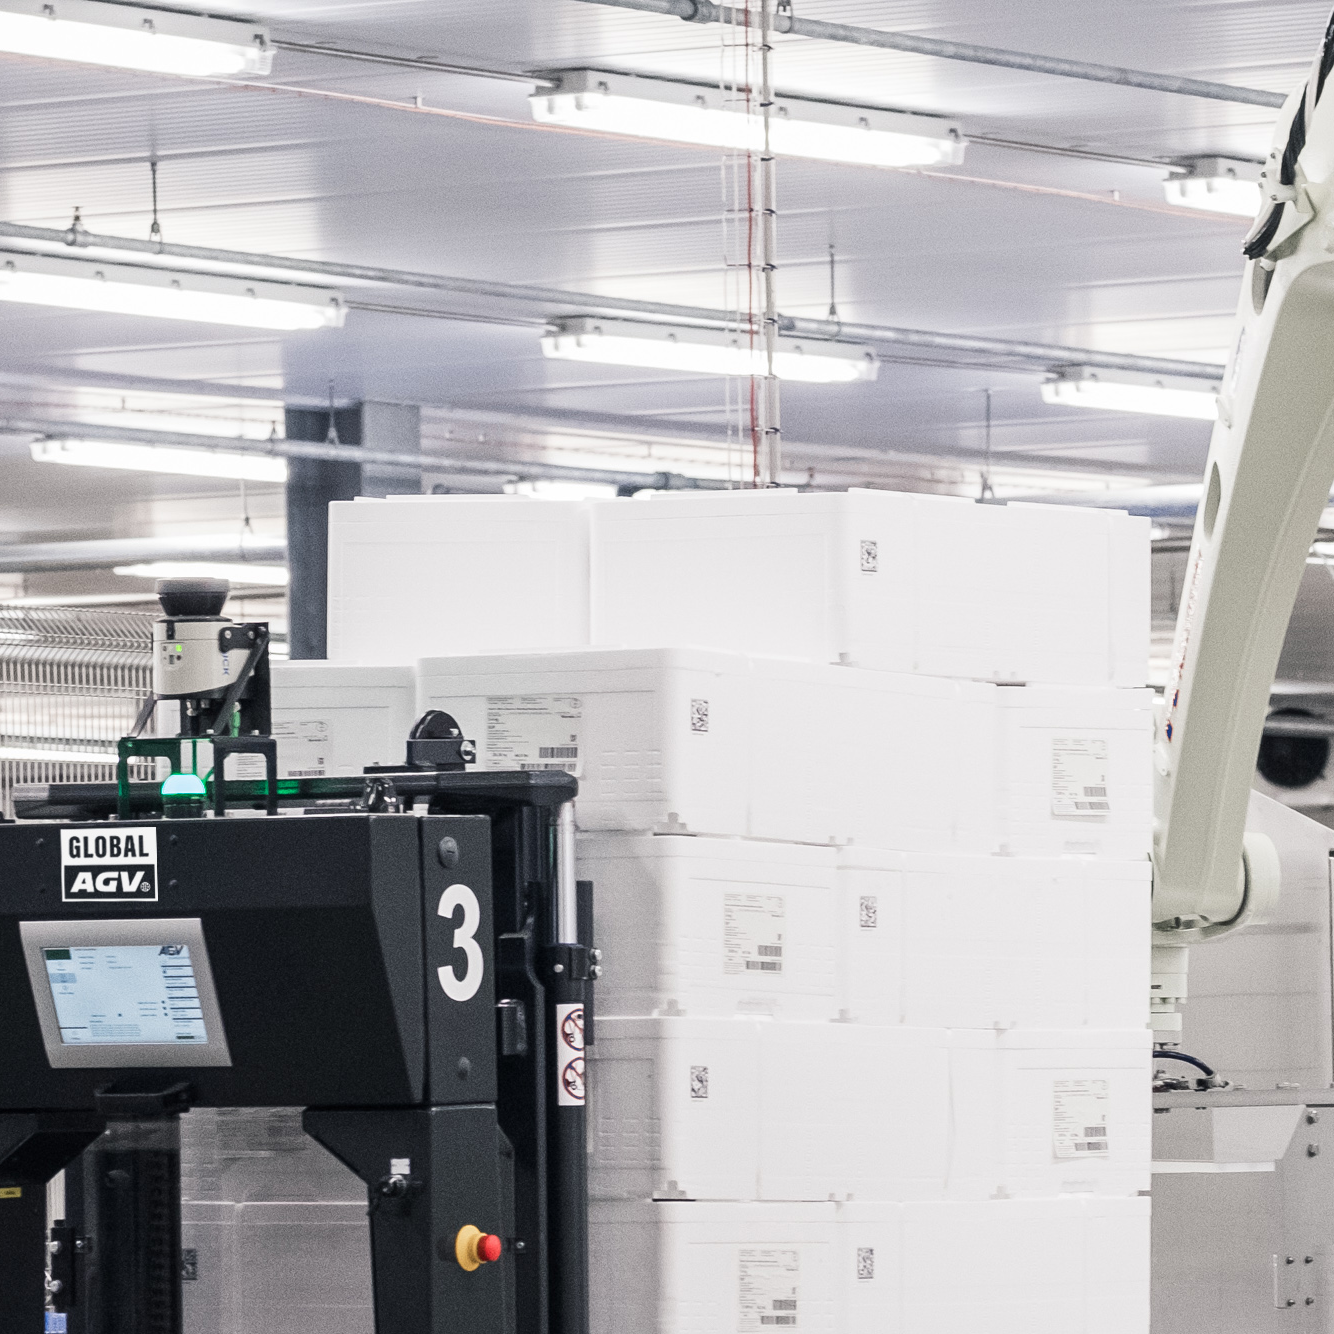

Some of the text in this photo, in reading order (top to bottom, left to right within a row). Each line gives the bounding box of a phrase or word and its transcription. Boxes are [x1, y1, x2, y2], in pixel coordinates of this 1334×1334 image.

[69, 835, 149, 859] GLOBAL
[70, 871, 145, 893] AGV
[437, 883, 484, 1002] 3
